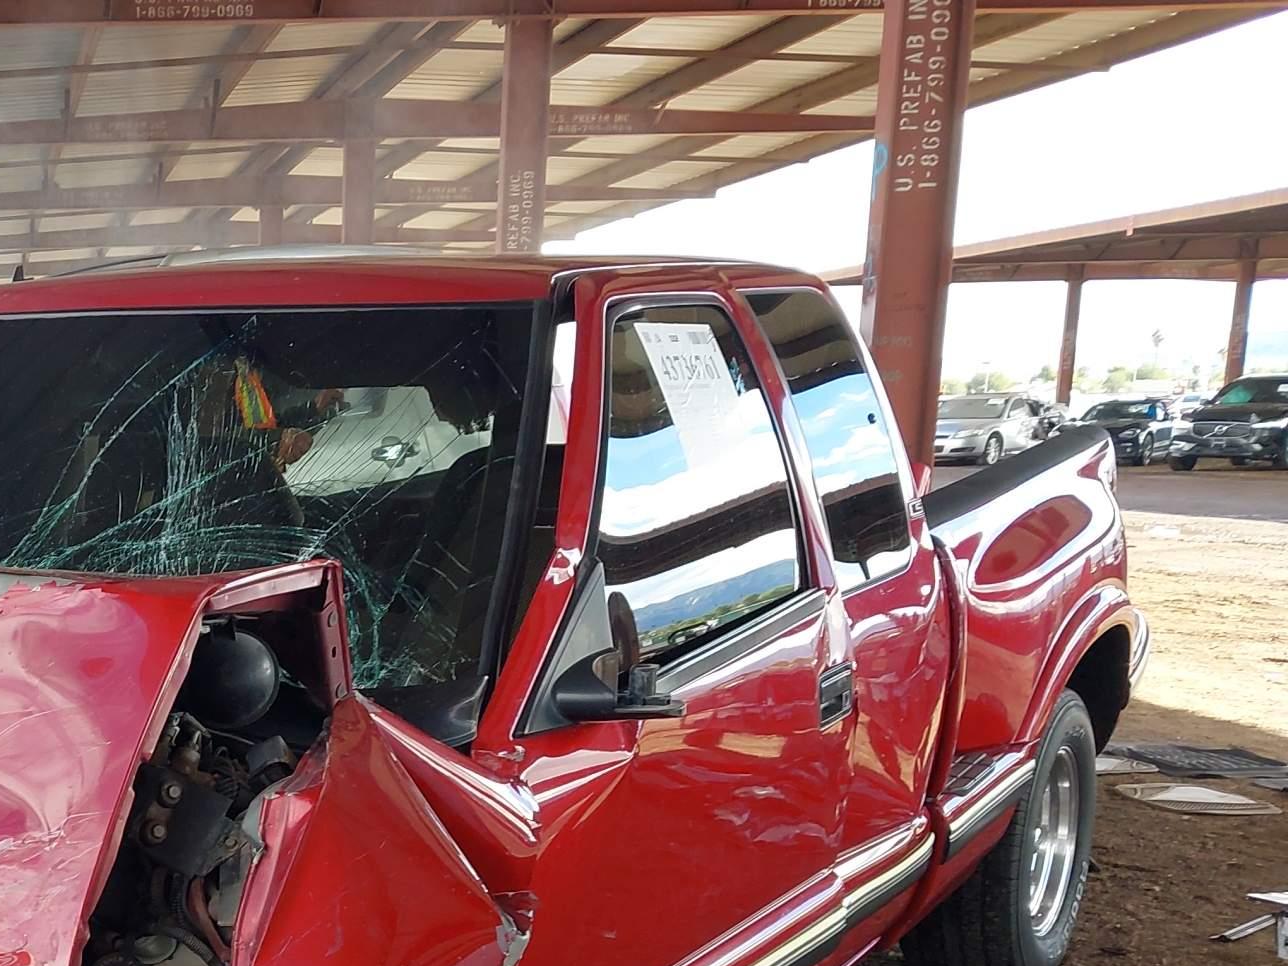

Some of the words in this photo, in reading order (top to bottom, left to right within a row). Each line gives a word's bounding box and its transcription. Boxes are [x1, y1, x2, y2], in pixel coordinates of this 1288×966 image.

[135, 4, 254, 19] 1-866-799-0969
[907, 0, 929, 20] IN
[899, 33, 926, 131] PREFAB
[894, 146, 917, 192] U.S.
[506, 204, 520, 249] REFAB
[520, 170, 534, 250] -799-0969
